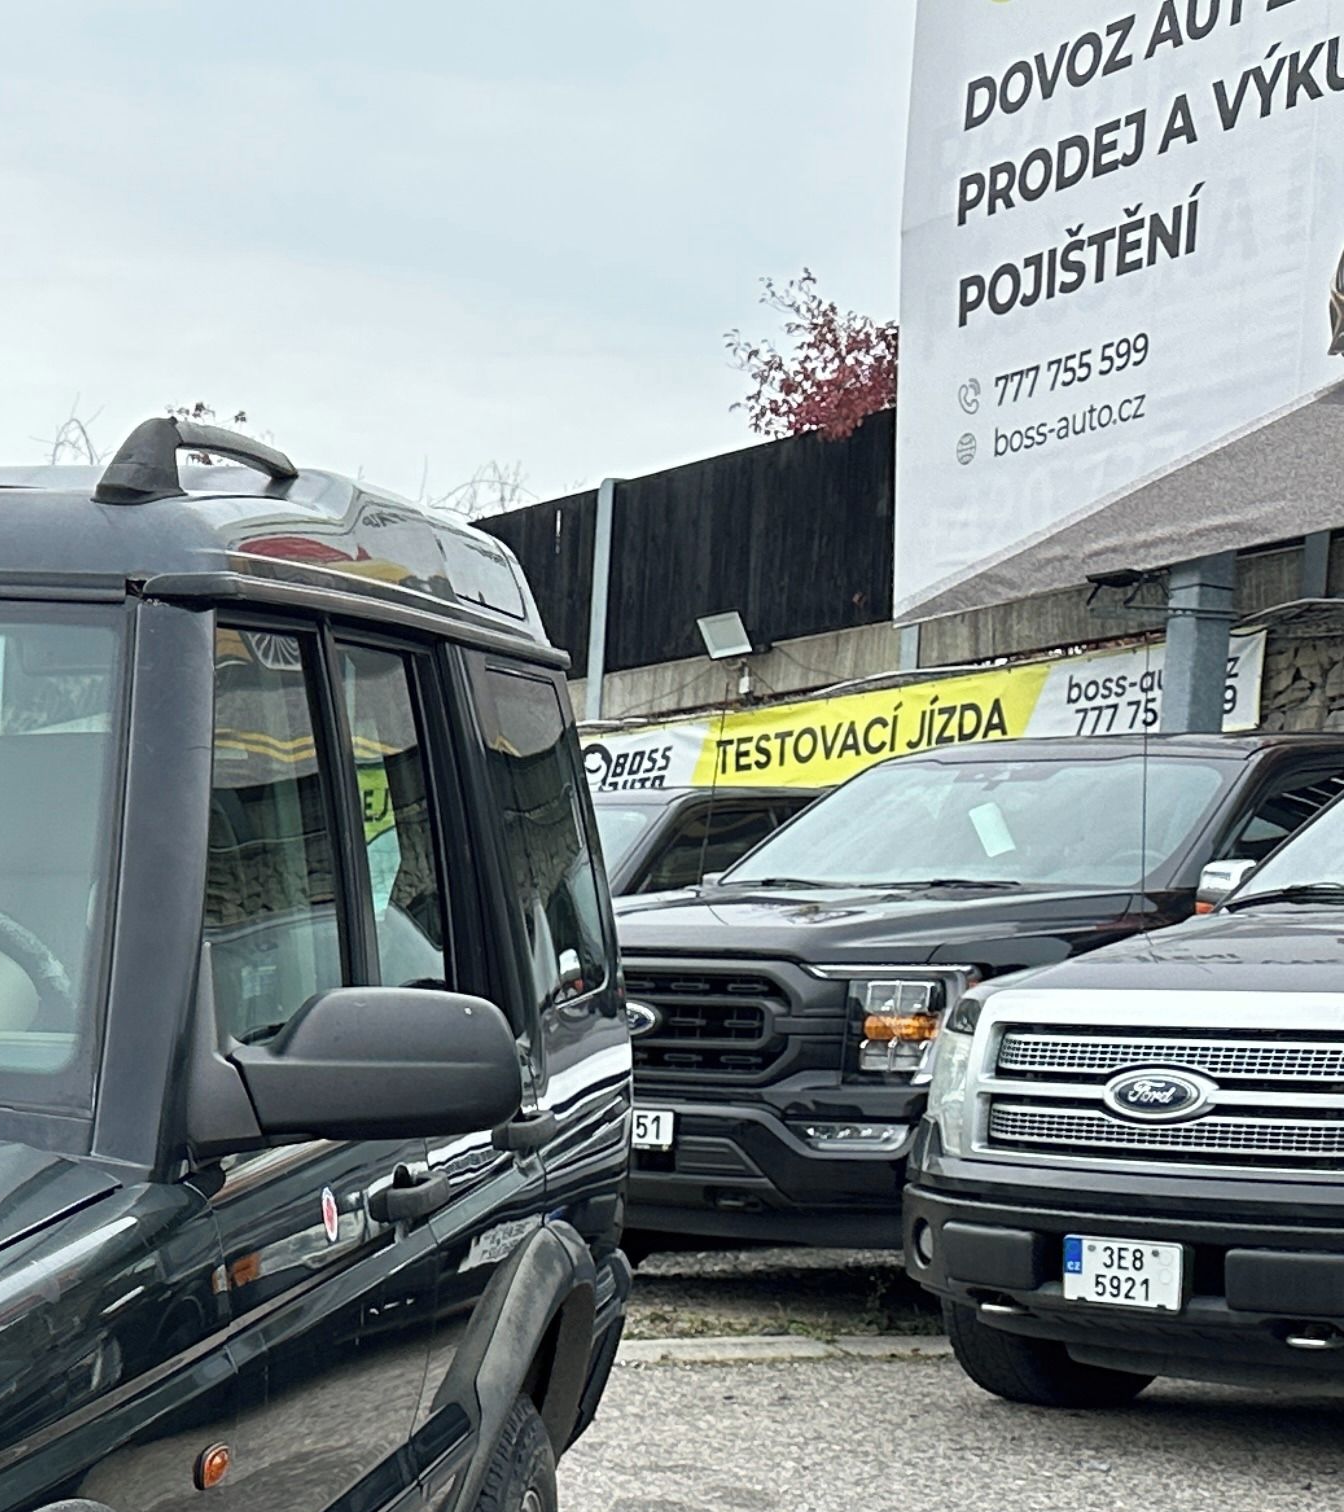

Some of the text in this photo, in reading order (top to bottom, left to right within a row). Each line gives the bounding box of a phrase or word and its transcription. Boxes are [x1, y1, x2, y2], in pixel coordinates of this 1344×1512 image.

[964, 14, 1136, 131] DOVOZ
[957, 109, 1147, 226] PRODEJ
[1157, 93, 1199, 155] A
[958, 181, 1206, 328] POJIŠTĚNÍ
[994, 332, 1149, 407] 777 755 599
[993, 394, 1146, 457] boss-auto.cz
[717, 695, 1008, 775] TESTOVACÍ JÍZDA
[1075, 696, 1159, 737] 777 75
[611, 744, 674, 778] BOSS
[1128, 1080, 1177, 1104] Ford
[1094, 1274, 1150, 1301] 5921
[1102, 1245, 1145, 1272] 3E8
